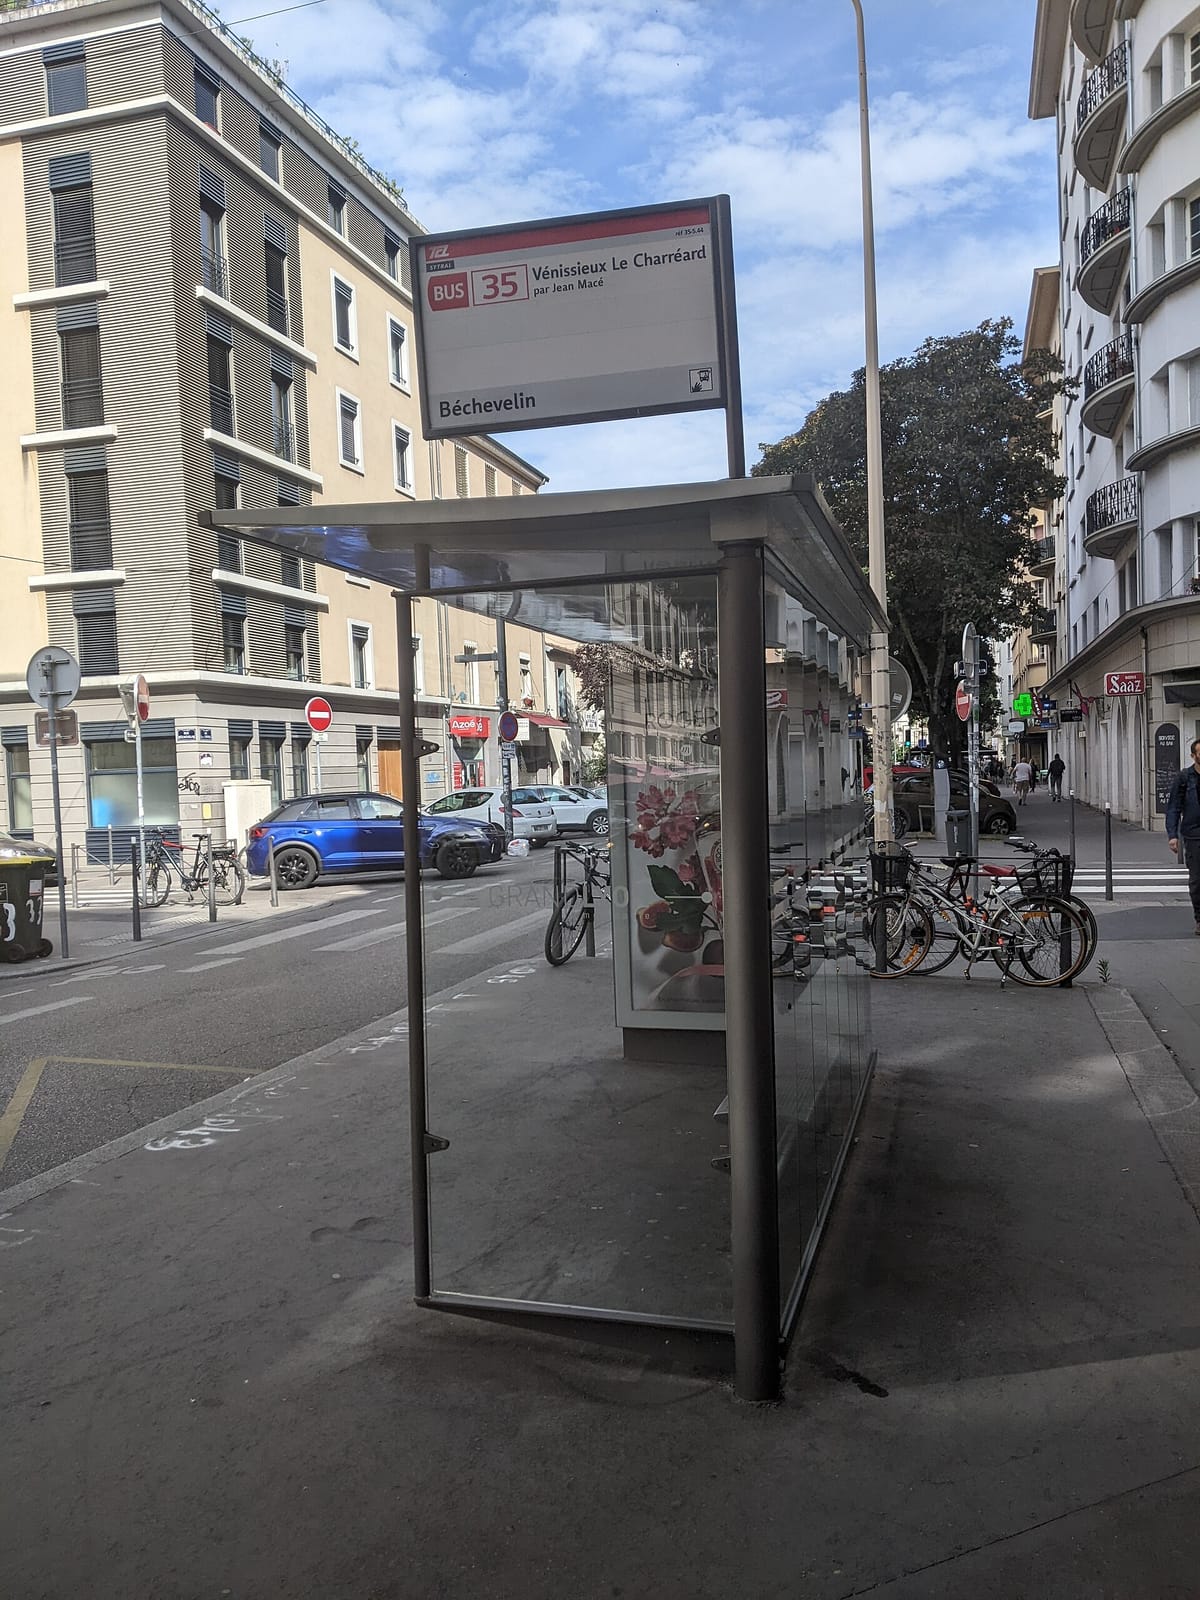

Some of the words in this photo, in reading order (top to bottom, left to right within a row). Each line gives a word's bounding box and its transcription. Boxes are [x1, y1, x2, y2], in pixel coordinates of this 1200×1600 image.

[532, 261, 607, 281] Vénissieux
[612, 257, 628, 270] Le
[633, 245, 707, 268] Charréard
[433, 283, 465, 301] BUS
[482, 272, 518, 299] 35
[533, 286, 549, 297] par
[552, 283, 574, 293] Jean
[578, 277, 604, 290] Macé
[439, 392, 536, 418] Béchevelin
[1108, 674, 1142, 694] Saaz
